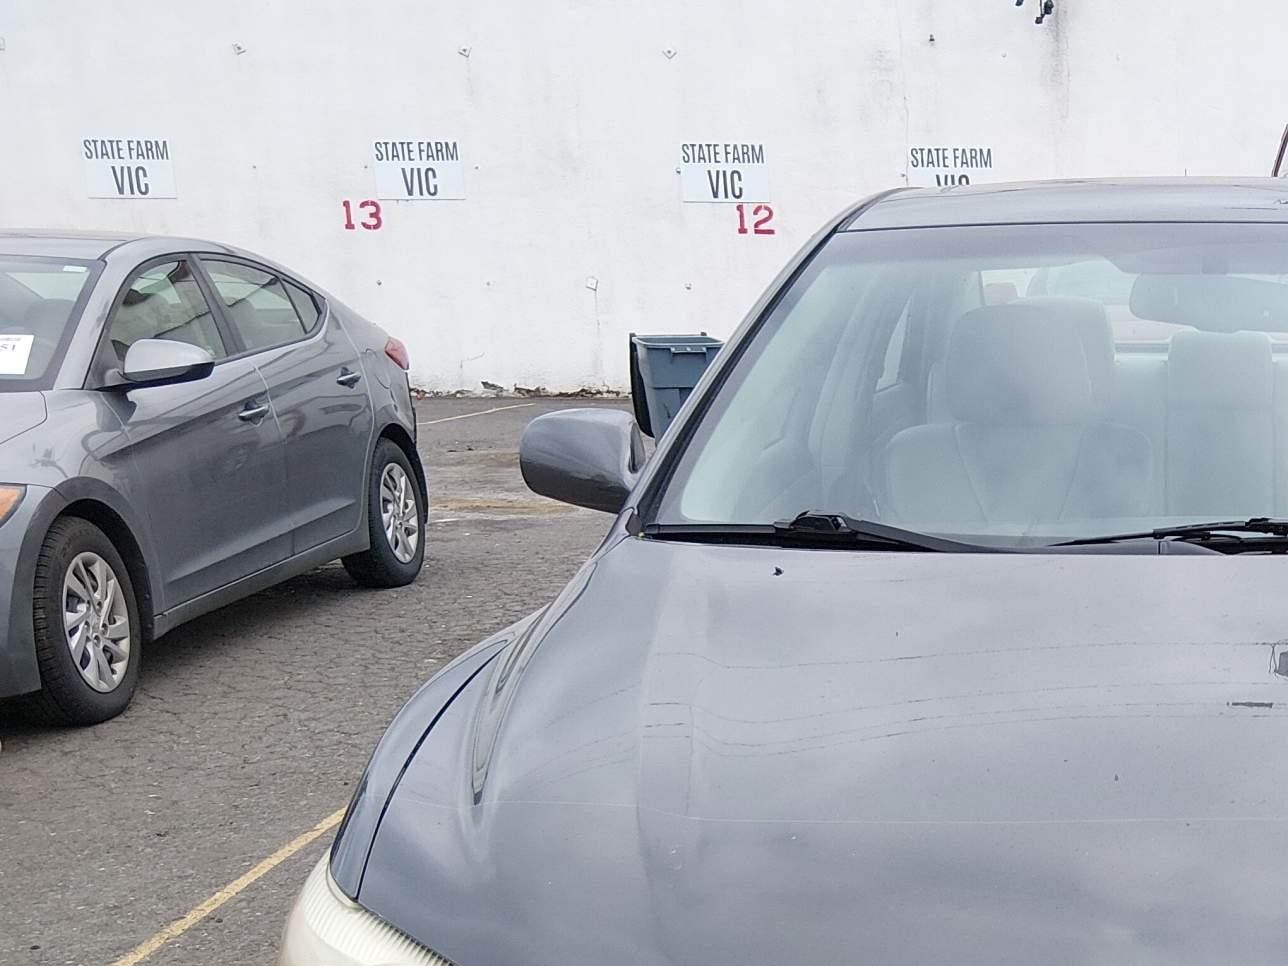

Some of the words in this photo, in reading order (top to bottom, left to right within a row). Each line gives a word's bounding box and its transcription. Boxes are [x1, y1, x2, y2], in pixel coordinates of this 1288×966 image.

[83, 139, 125, 160] STATE
[127, 140, 169, 161] FARM
[374, 141, 416, 162] STATE
[418, 141, 459, 162] FARM
[681, 143, 721, 164] STATE
[723, 143, 765, 164] FARM
[910, 147, 950, 168] STATE
[952, 147, 993, 169] FARM
[111, 165, 150, 196] VIC
[401, 167, 439, 197] VIC
[707, 169, 744, 200] VIC
[342, 199, 383, 231] 13
[736, 203, 776, 235] 12
